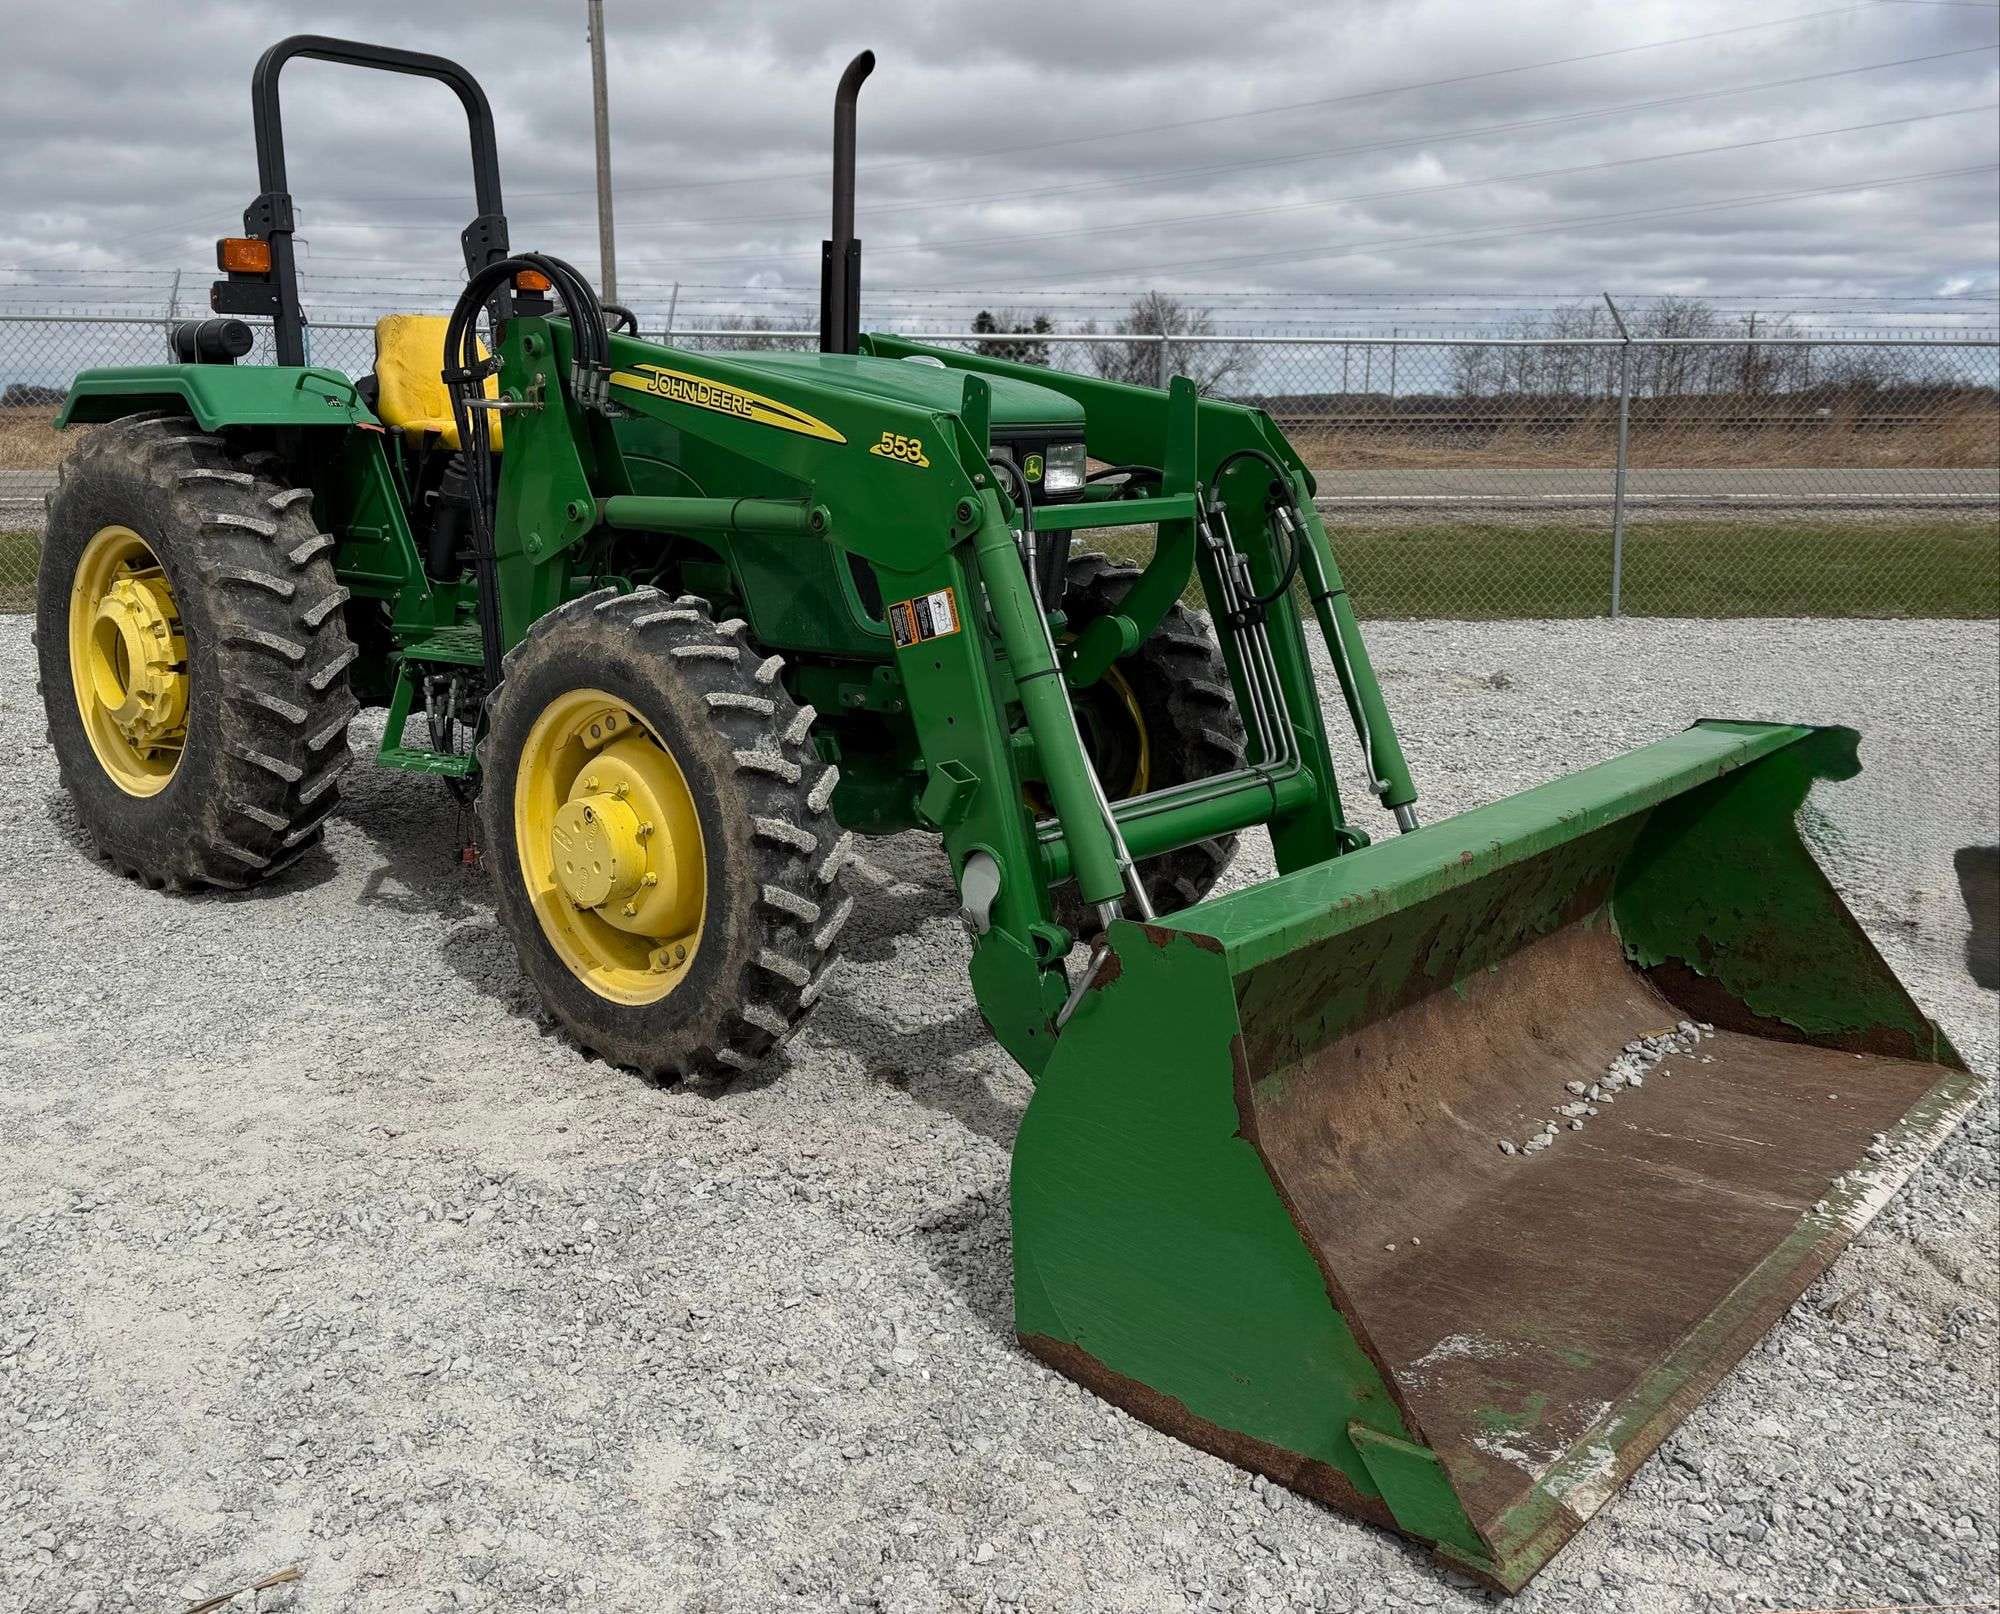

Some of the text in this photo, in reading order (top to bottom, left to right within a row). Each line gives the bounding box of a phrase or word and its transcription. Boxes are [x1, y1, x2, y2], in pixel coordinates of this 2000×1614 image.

[647, 370, 754, 416] JOHN DEERE
[880, 431, 922, 463] 553
